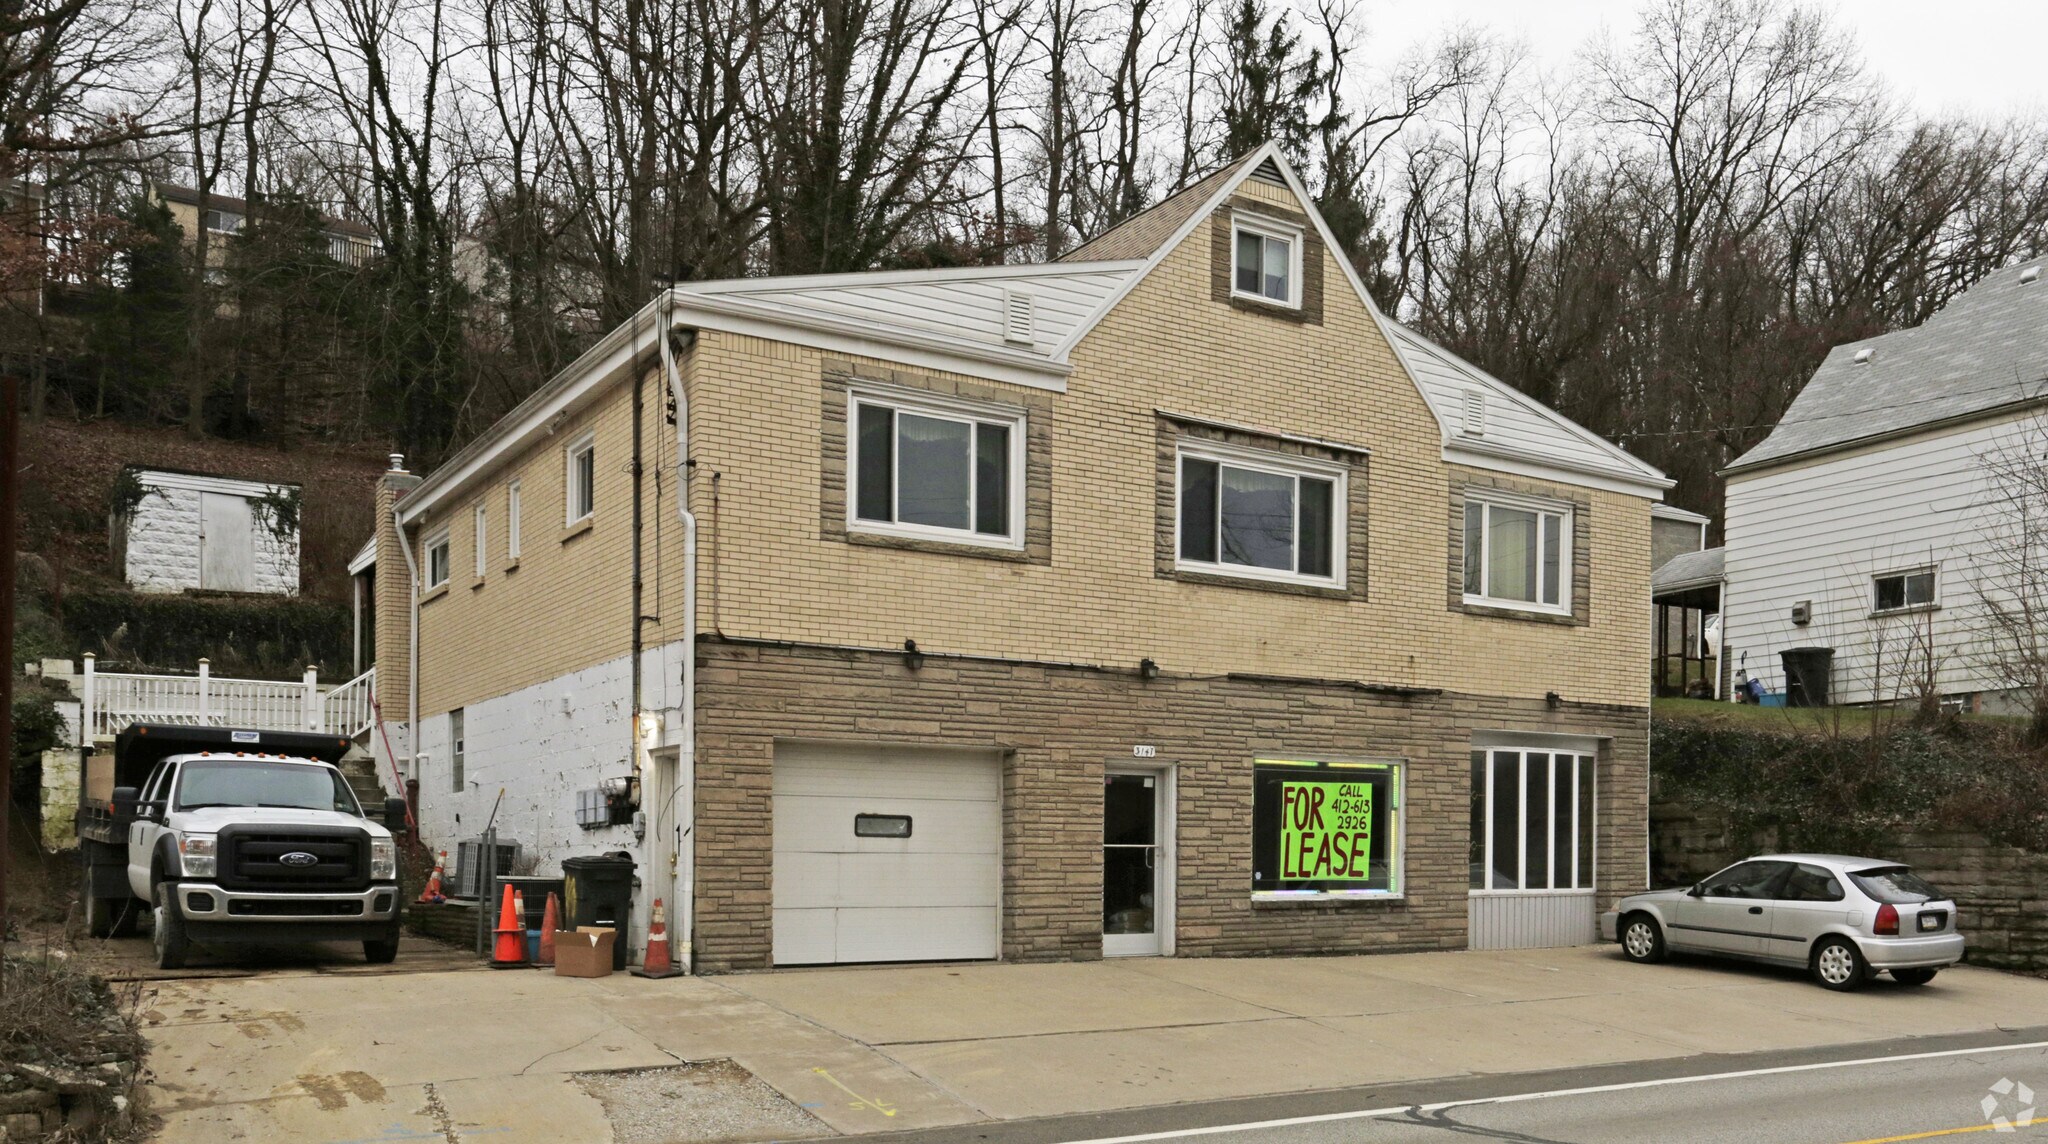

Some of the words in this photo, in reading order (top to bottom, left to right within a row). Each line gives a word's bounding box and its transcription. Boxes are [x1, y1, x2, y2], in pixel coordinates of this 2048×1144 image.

[1339, 784, 1363, 798] CALL
[1283, 786, 1325, 831] FOR
[1331, 798, 1371, 814] 412-613
[1337, 815, 1367, 830] 2926
[1283, 831, 1369, 878] LEASE
